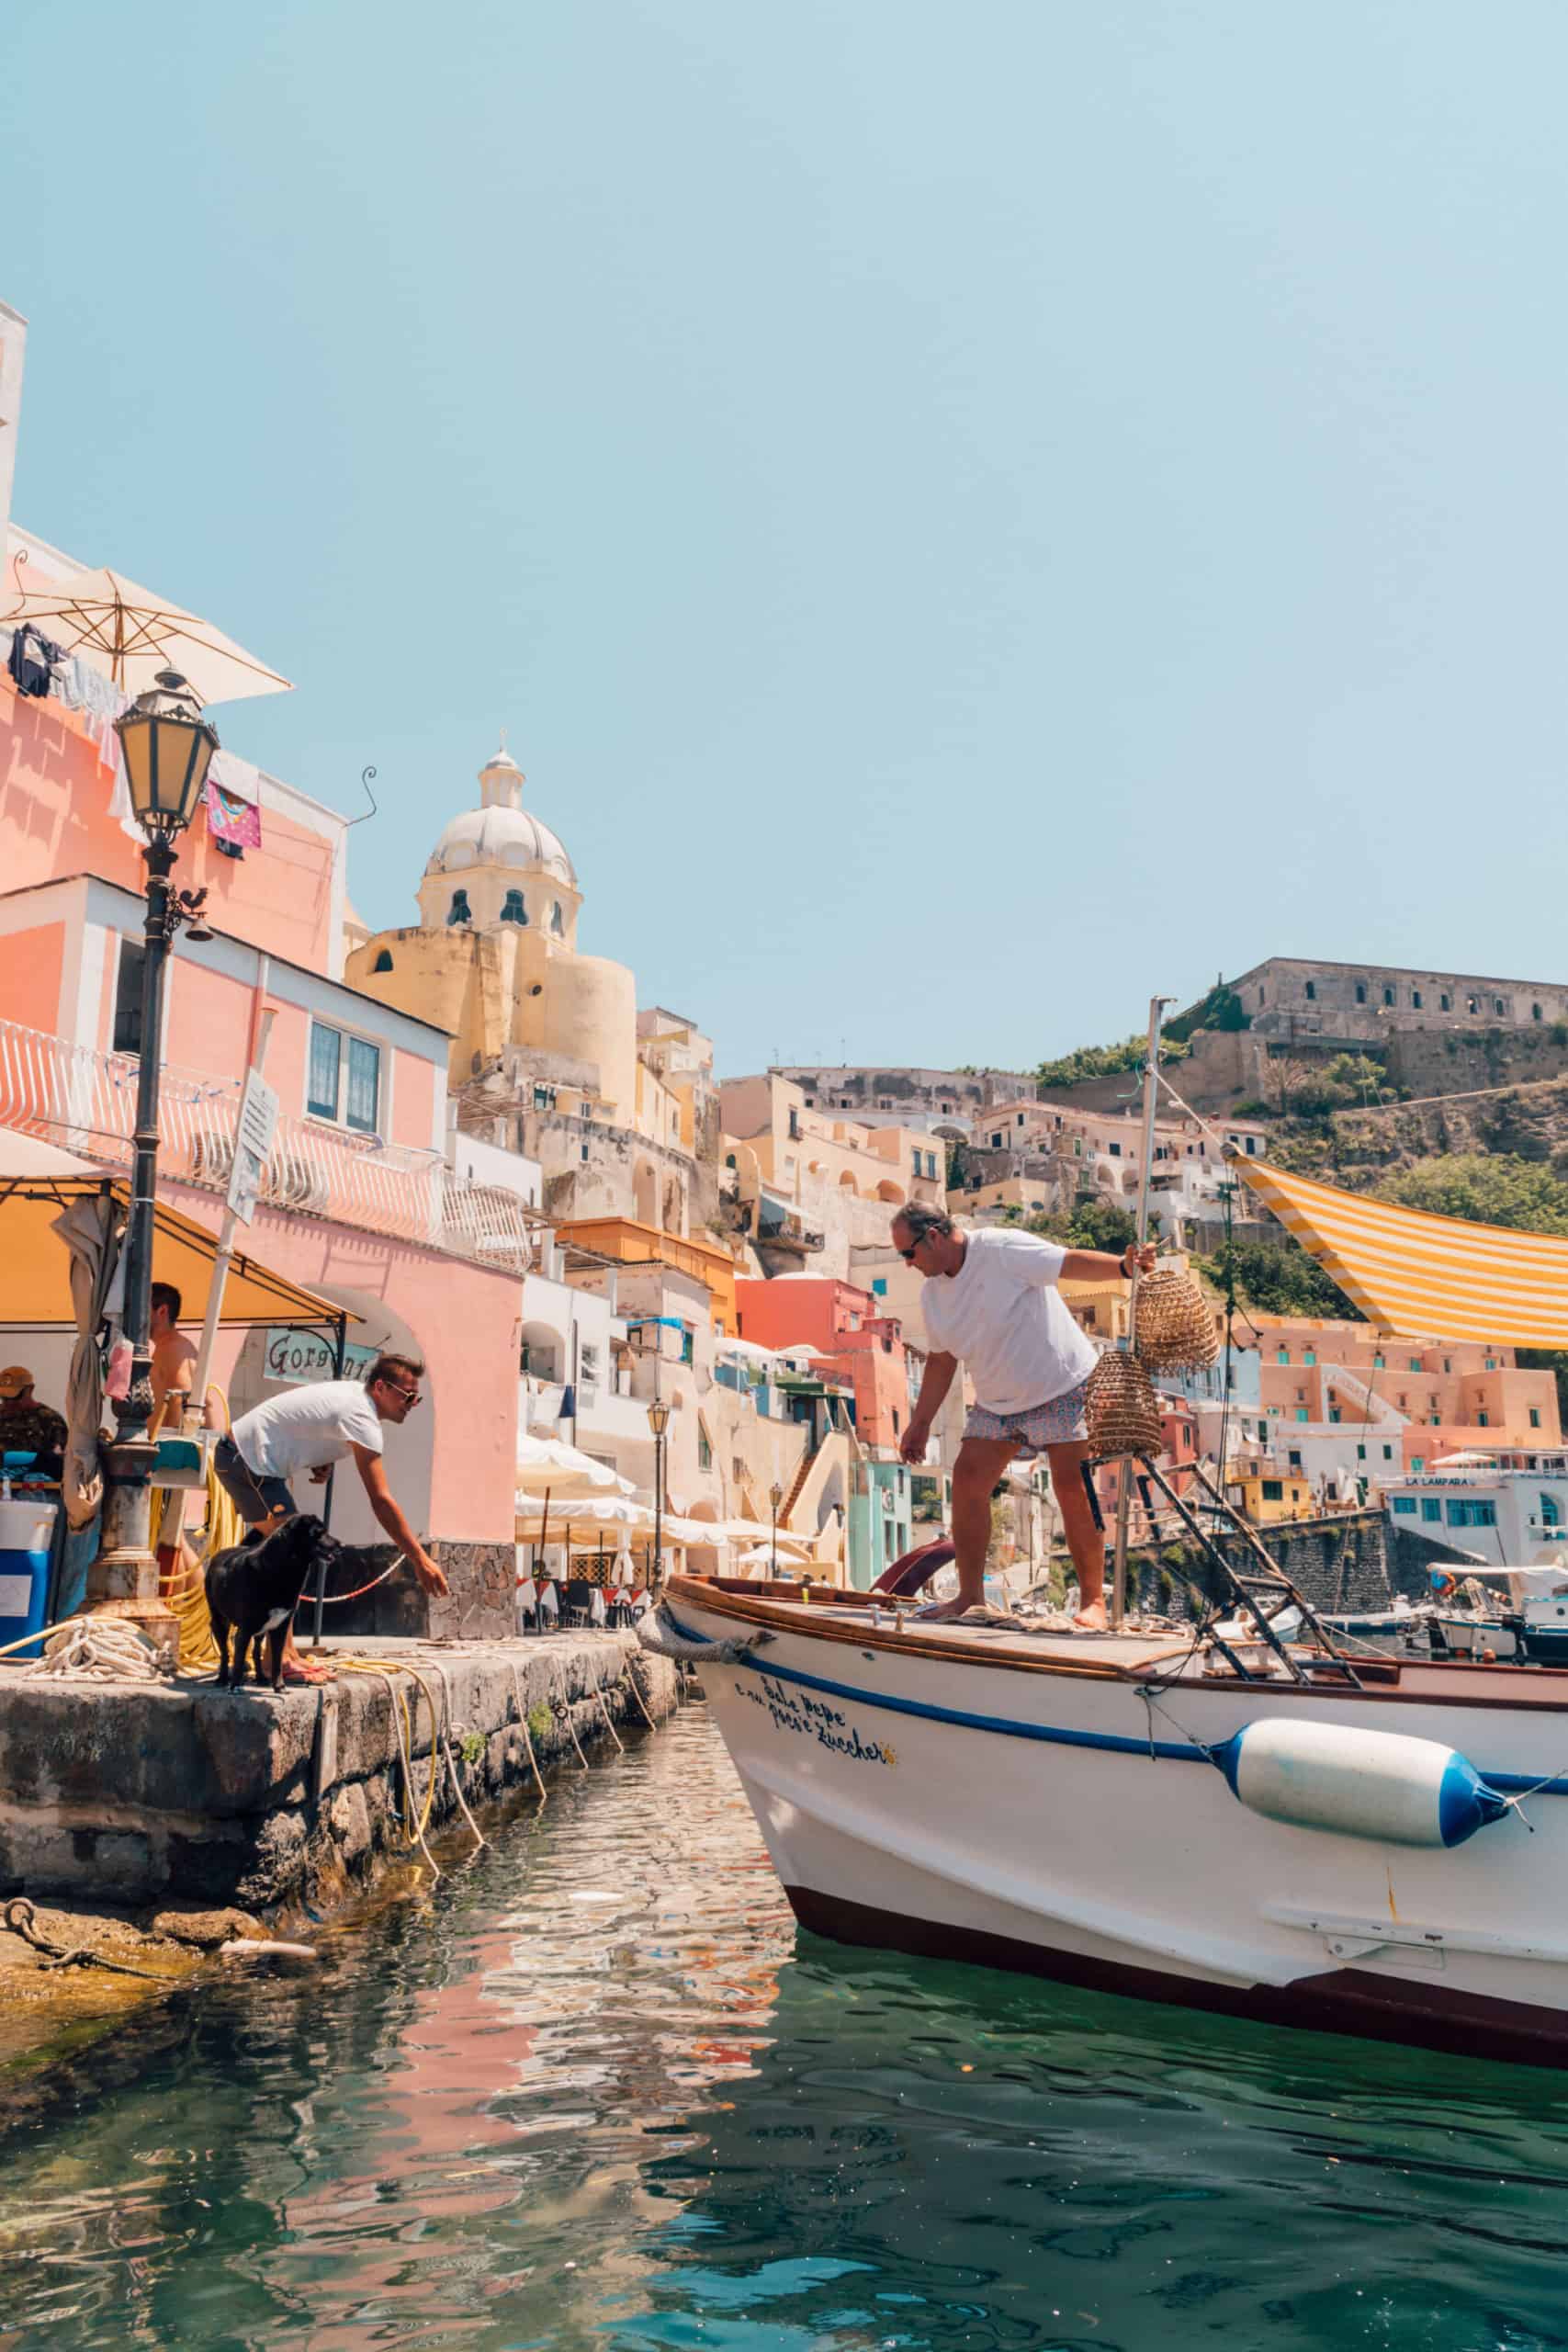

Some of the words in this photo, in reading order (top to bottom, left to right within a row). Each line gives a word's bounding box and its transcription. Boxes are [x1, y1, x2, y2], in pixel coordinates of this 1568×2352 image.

[269, 1334, 369, 1382] Gorgni
[1405, 1477, 1418, 1486] LA
[1422, 1477, 1468, 1486] LAMPARA
[797, 1690, 847, 1728] pepe
